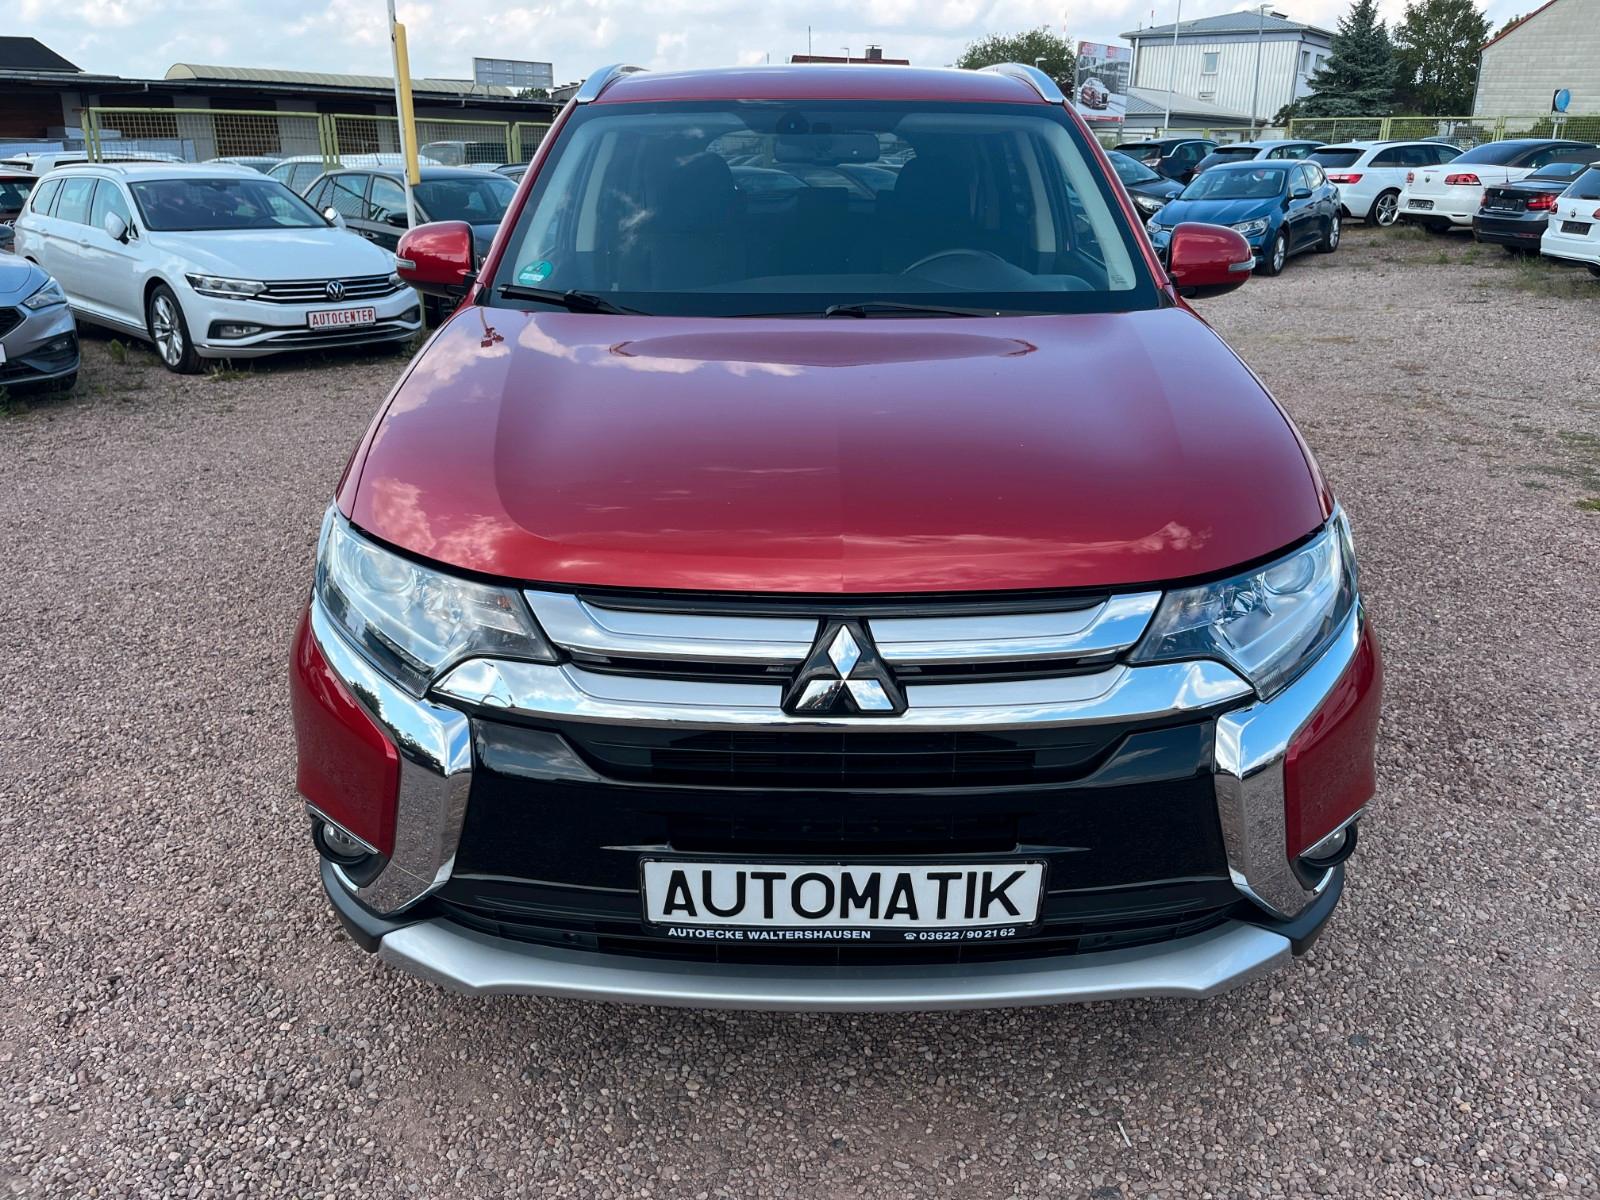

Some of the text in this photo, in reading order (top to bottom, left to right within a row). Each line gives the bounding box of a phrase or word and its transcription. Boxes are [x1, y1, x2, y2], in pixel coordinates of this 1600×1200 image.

[312, 309, 373, 326] AUTOCENTER
[663, 870, 1026, 920] AUTOMATIK
[668, 928, 744, 939] AUTOECKE
[747, 930, 871, 940] WALTERSHAUSEN
